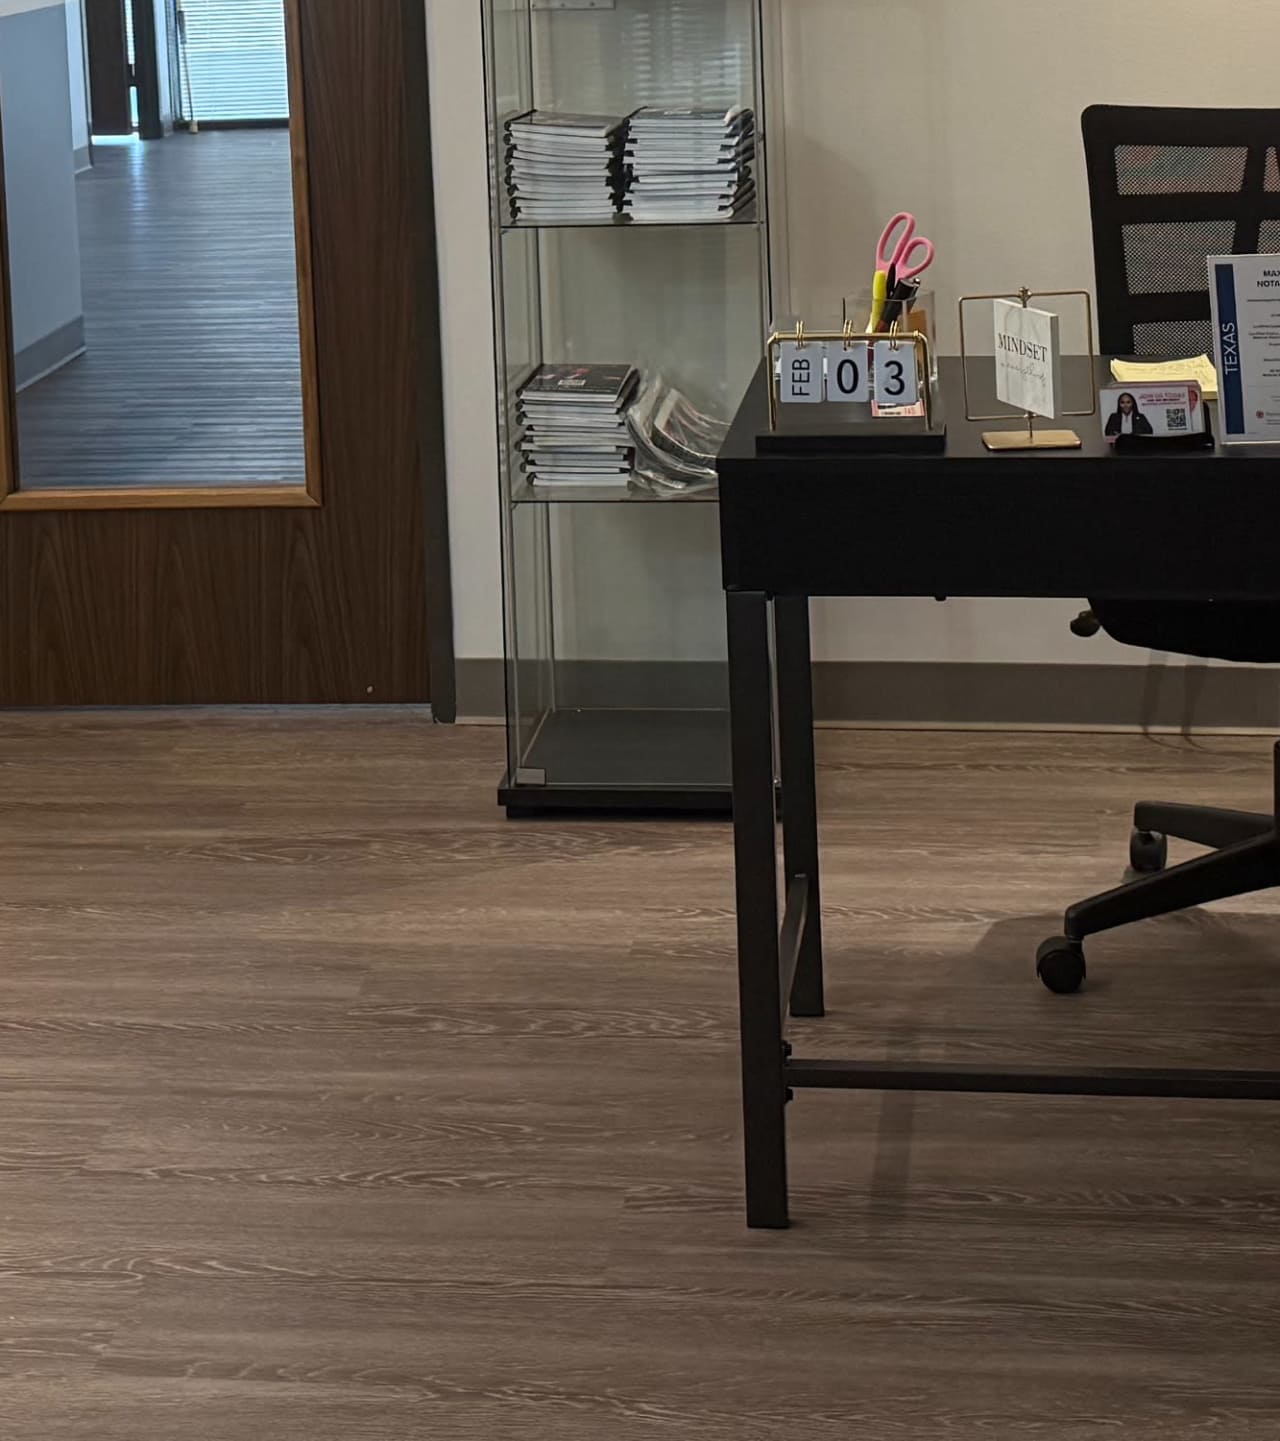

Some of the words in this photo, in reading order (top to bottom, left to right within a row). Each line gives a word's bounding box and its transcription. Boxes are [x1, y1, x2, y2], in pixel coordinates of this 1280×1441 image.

[998, 332, 1047, 362] MINDSET
[1222, 322, 1238, 375] TEXAS
[792, 359, 810, 396] FEB
